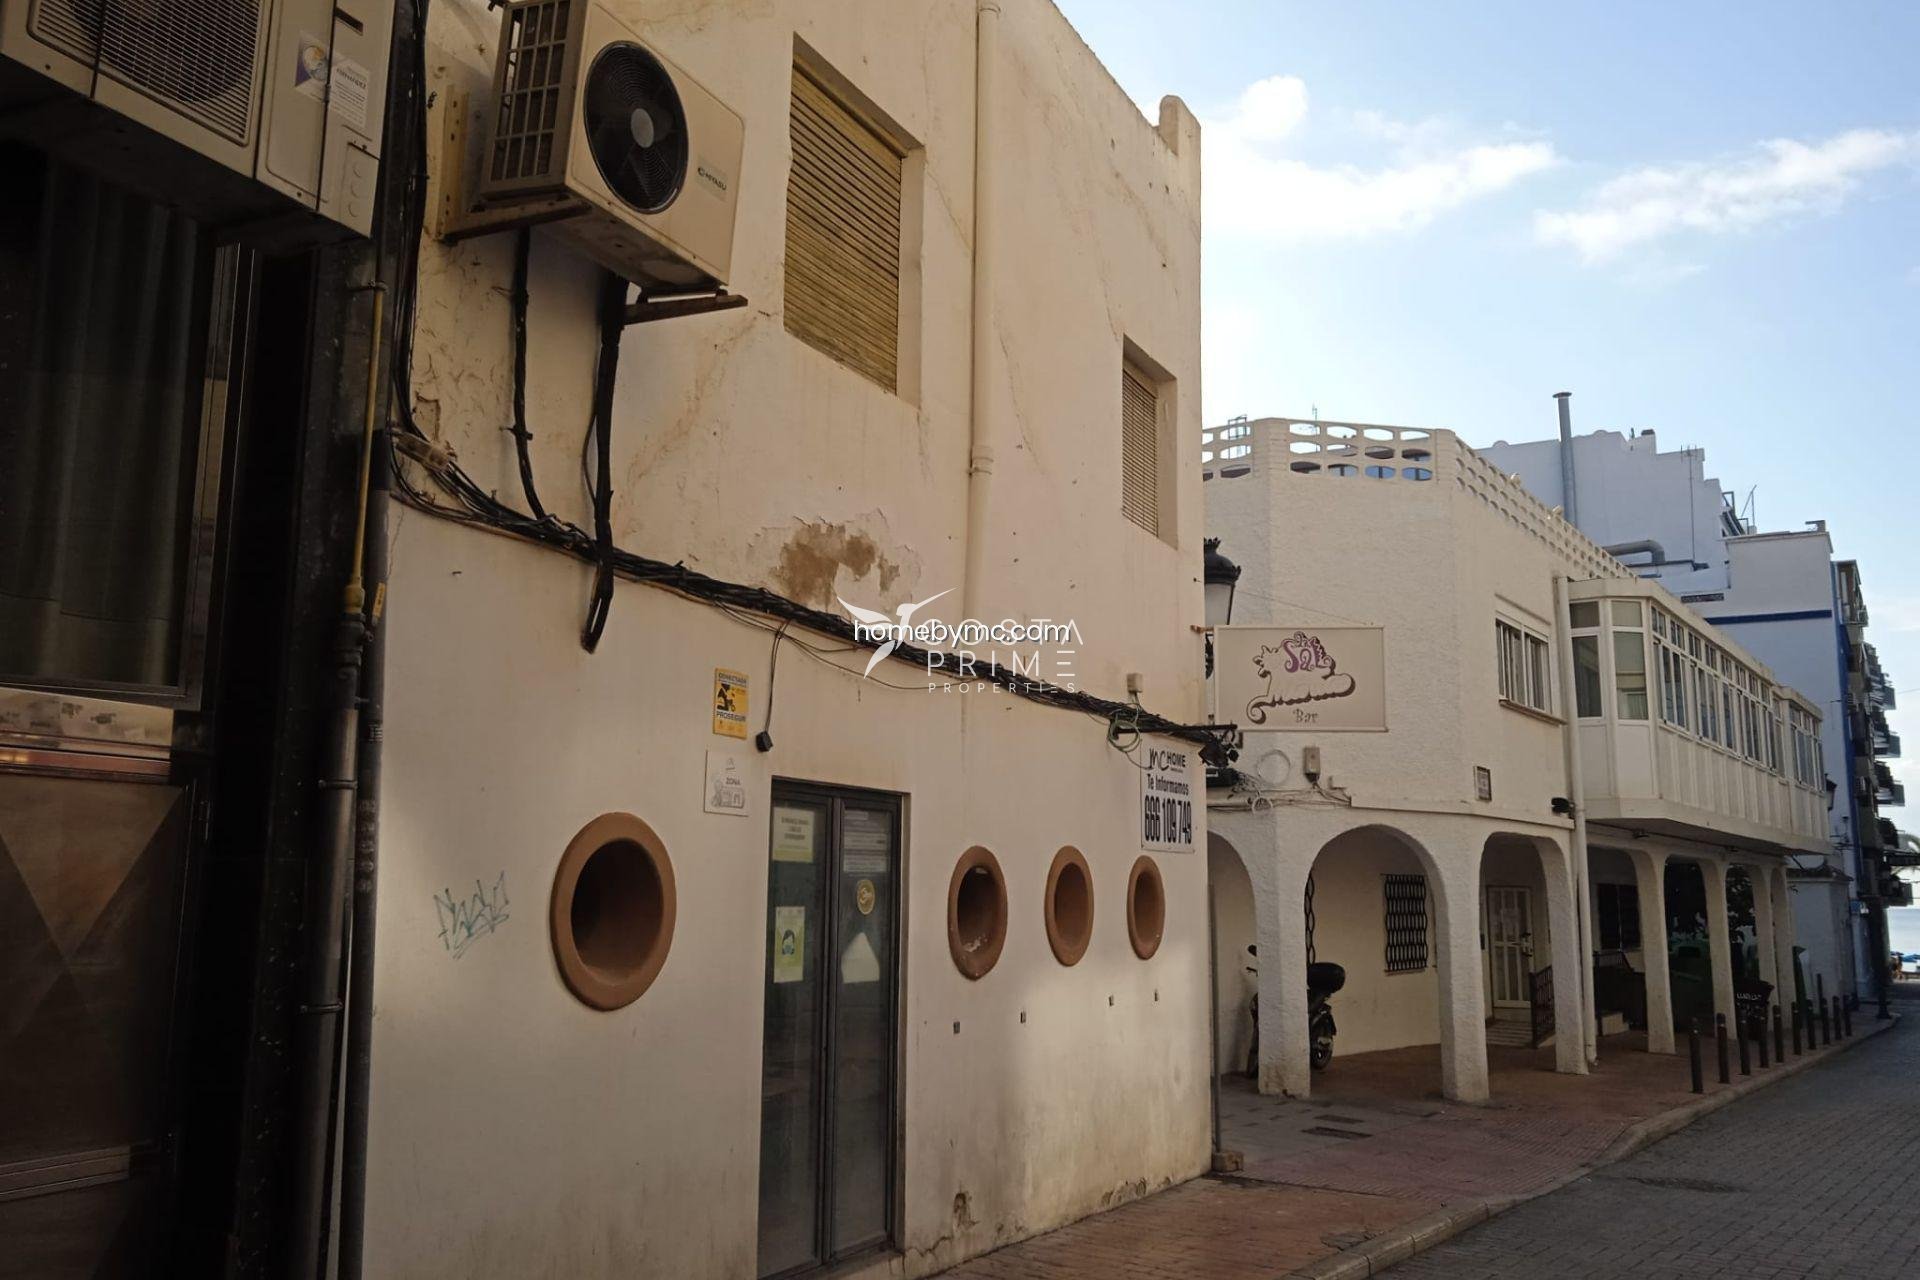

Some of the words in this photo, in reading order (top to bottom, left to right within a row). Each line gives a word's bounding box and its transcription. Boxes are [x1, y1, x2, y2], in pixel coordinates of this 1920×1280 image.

[1293, 708, 1319, 723] Bar
[1166, 751, 1186, 768] HOME
[1144, 794, 1161, 842] 666
[1162, 797, 1177, 844] 109
[1178, 800, 1192, 845] 749
